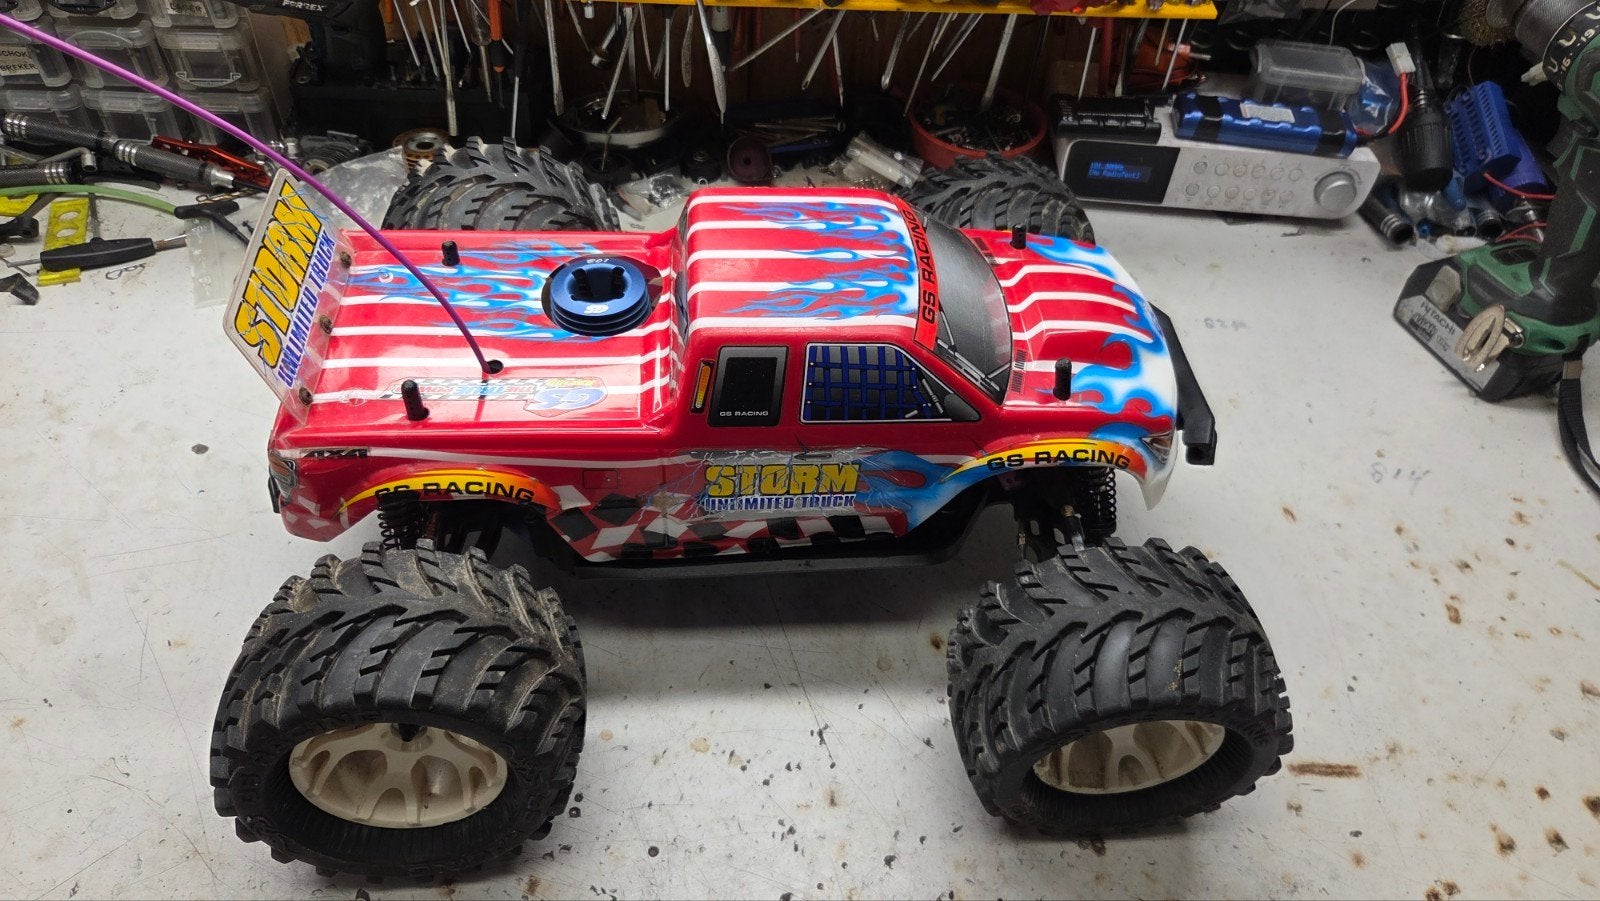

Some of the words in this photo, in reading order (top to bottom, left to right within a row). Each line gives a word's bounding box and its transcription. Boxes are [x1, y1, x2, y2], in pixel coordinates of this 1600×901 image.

[902, 208, 938, 285] RACING
[234, 179, 323, 369] STORM
[277, 285, 319, 388] UNLIMITED
[308, 229, 336, 291] TRUCK
[921, 288, 937, 325] GS
[1420, 301, 1456, 336] HITACHI
[986, 453, 1024, 471] GS
[1034, 449, 1132, 470] RACING
[375, 485, 412, 501] GS
[422, 481, 536, 502] RACING
[704, 464, 859, 497] STORM
[704, 496, 794, 512] UNLIMITED
[800, 494, 857, 509] TRUCK
